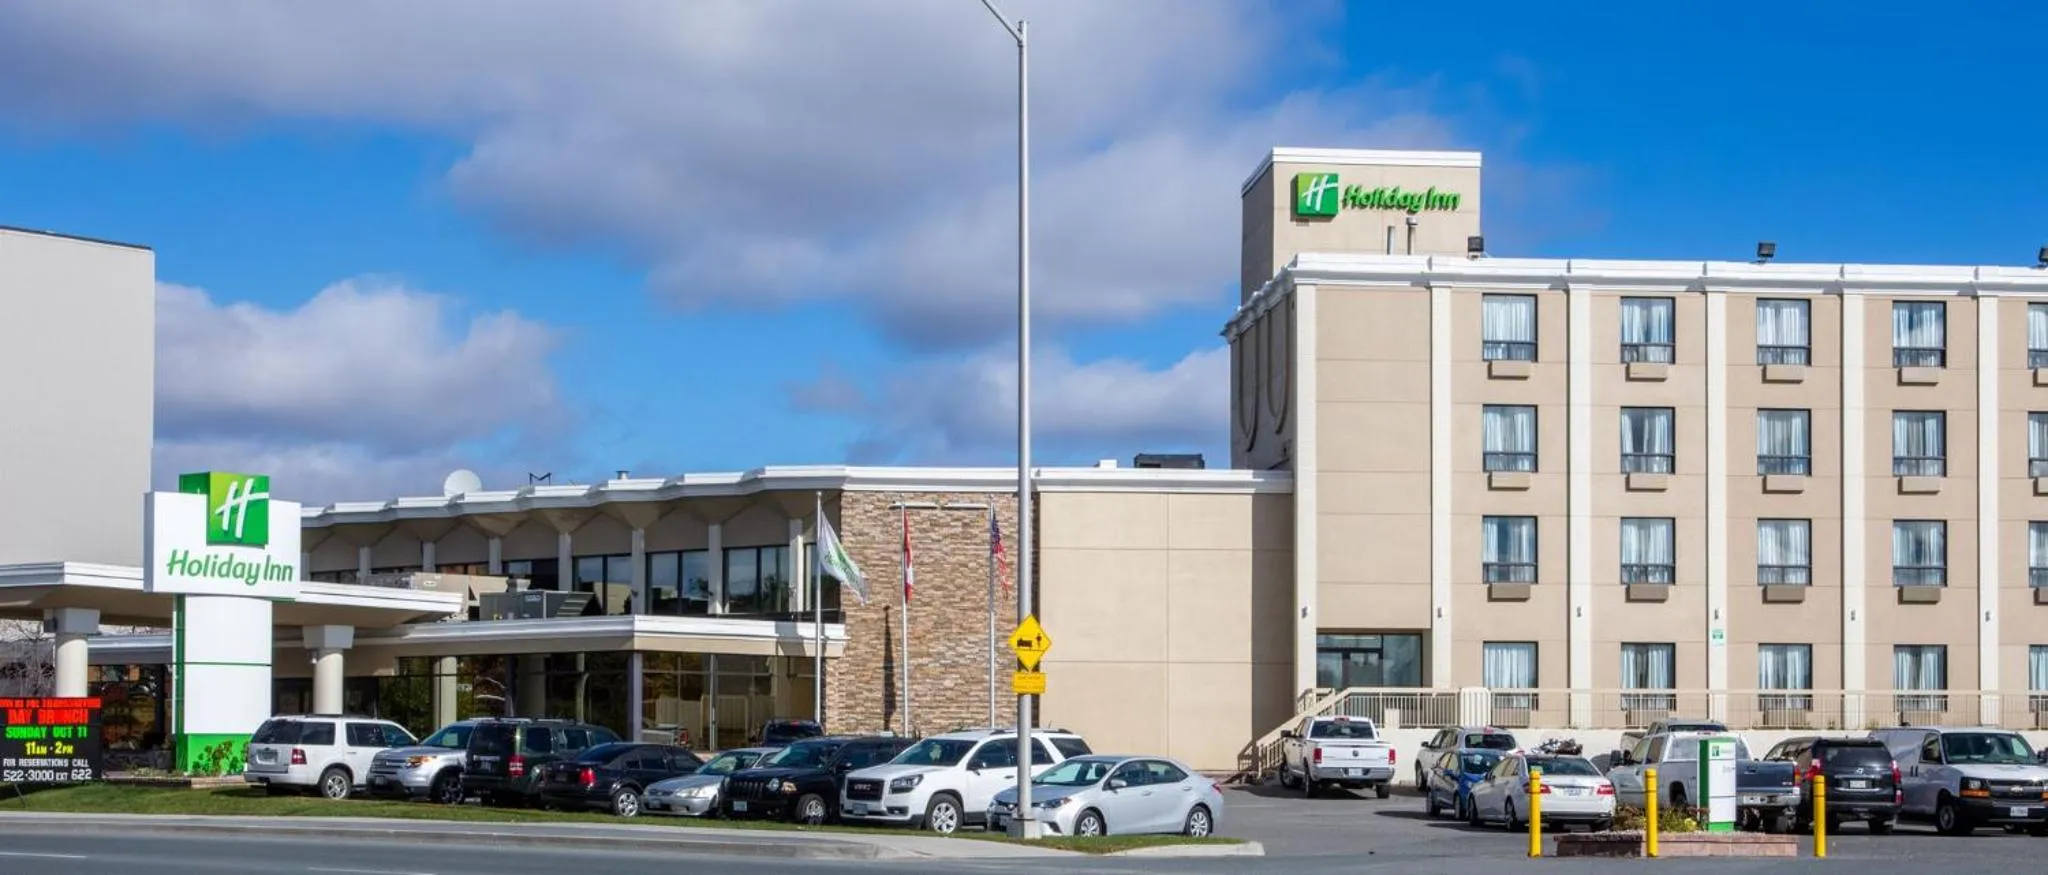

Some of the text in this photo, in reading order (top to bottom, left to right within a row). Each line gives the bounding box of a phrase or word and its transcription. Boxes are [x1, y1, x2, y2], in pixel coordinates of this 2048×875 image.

[1343, 184, 1460, 213] Holiday Inn
[216, 478, 269, 539] H
[167, 549, 293, 586] Holiday Inn
[8, 709, 88, 725] DAY BRNCH
[5, 726, 87, 738] SUNDAY OCT 11
[25, 742, 47, 755] 11AM
[55, 742, 73, 754] 2PM
[3, 758, 89, 767] FOR RESERVATIONS CALL
[56, 772, 68, 780] EXT
[71, 769, 92, 780] 622
